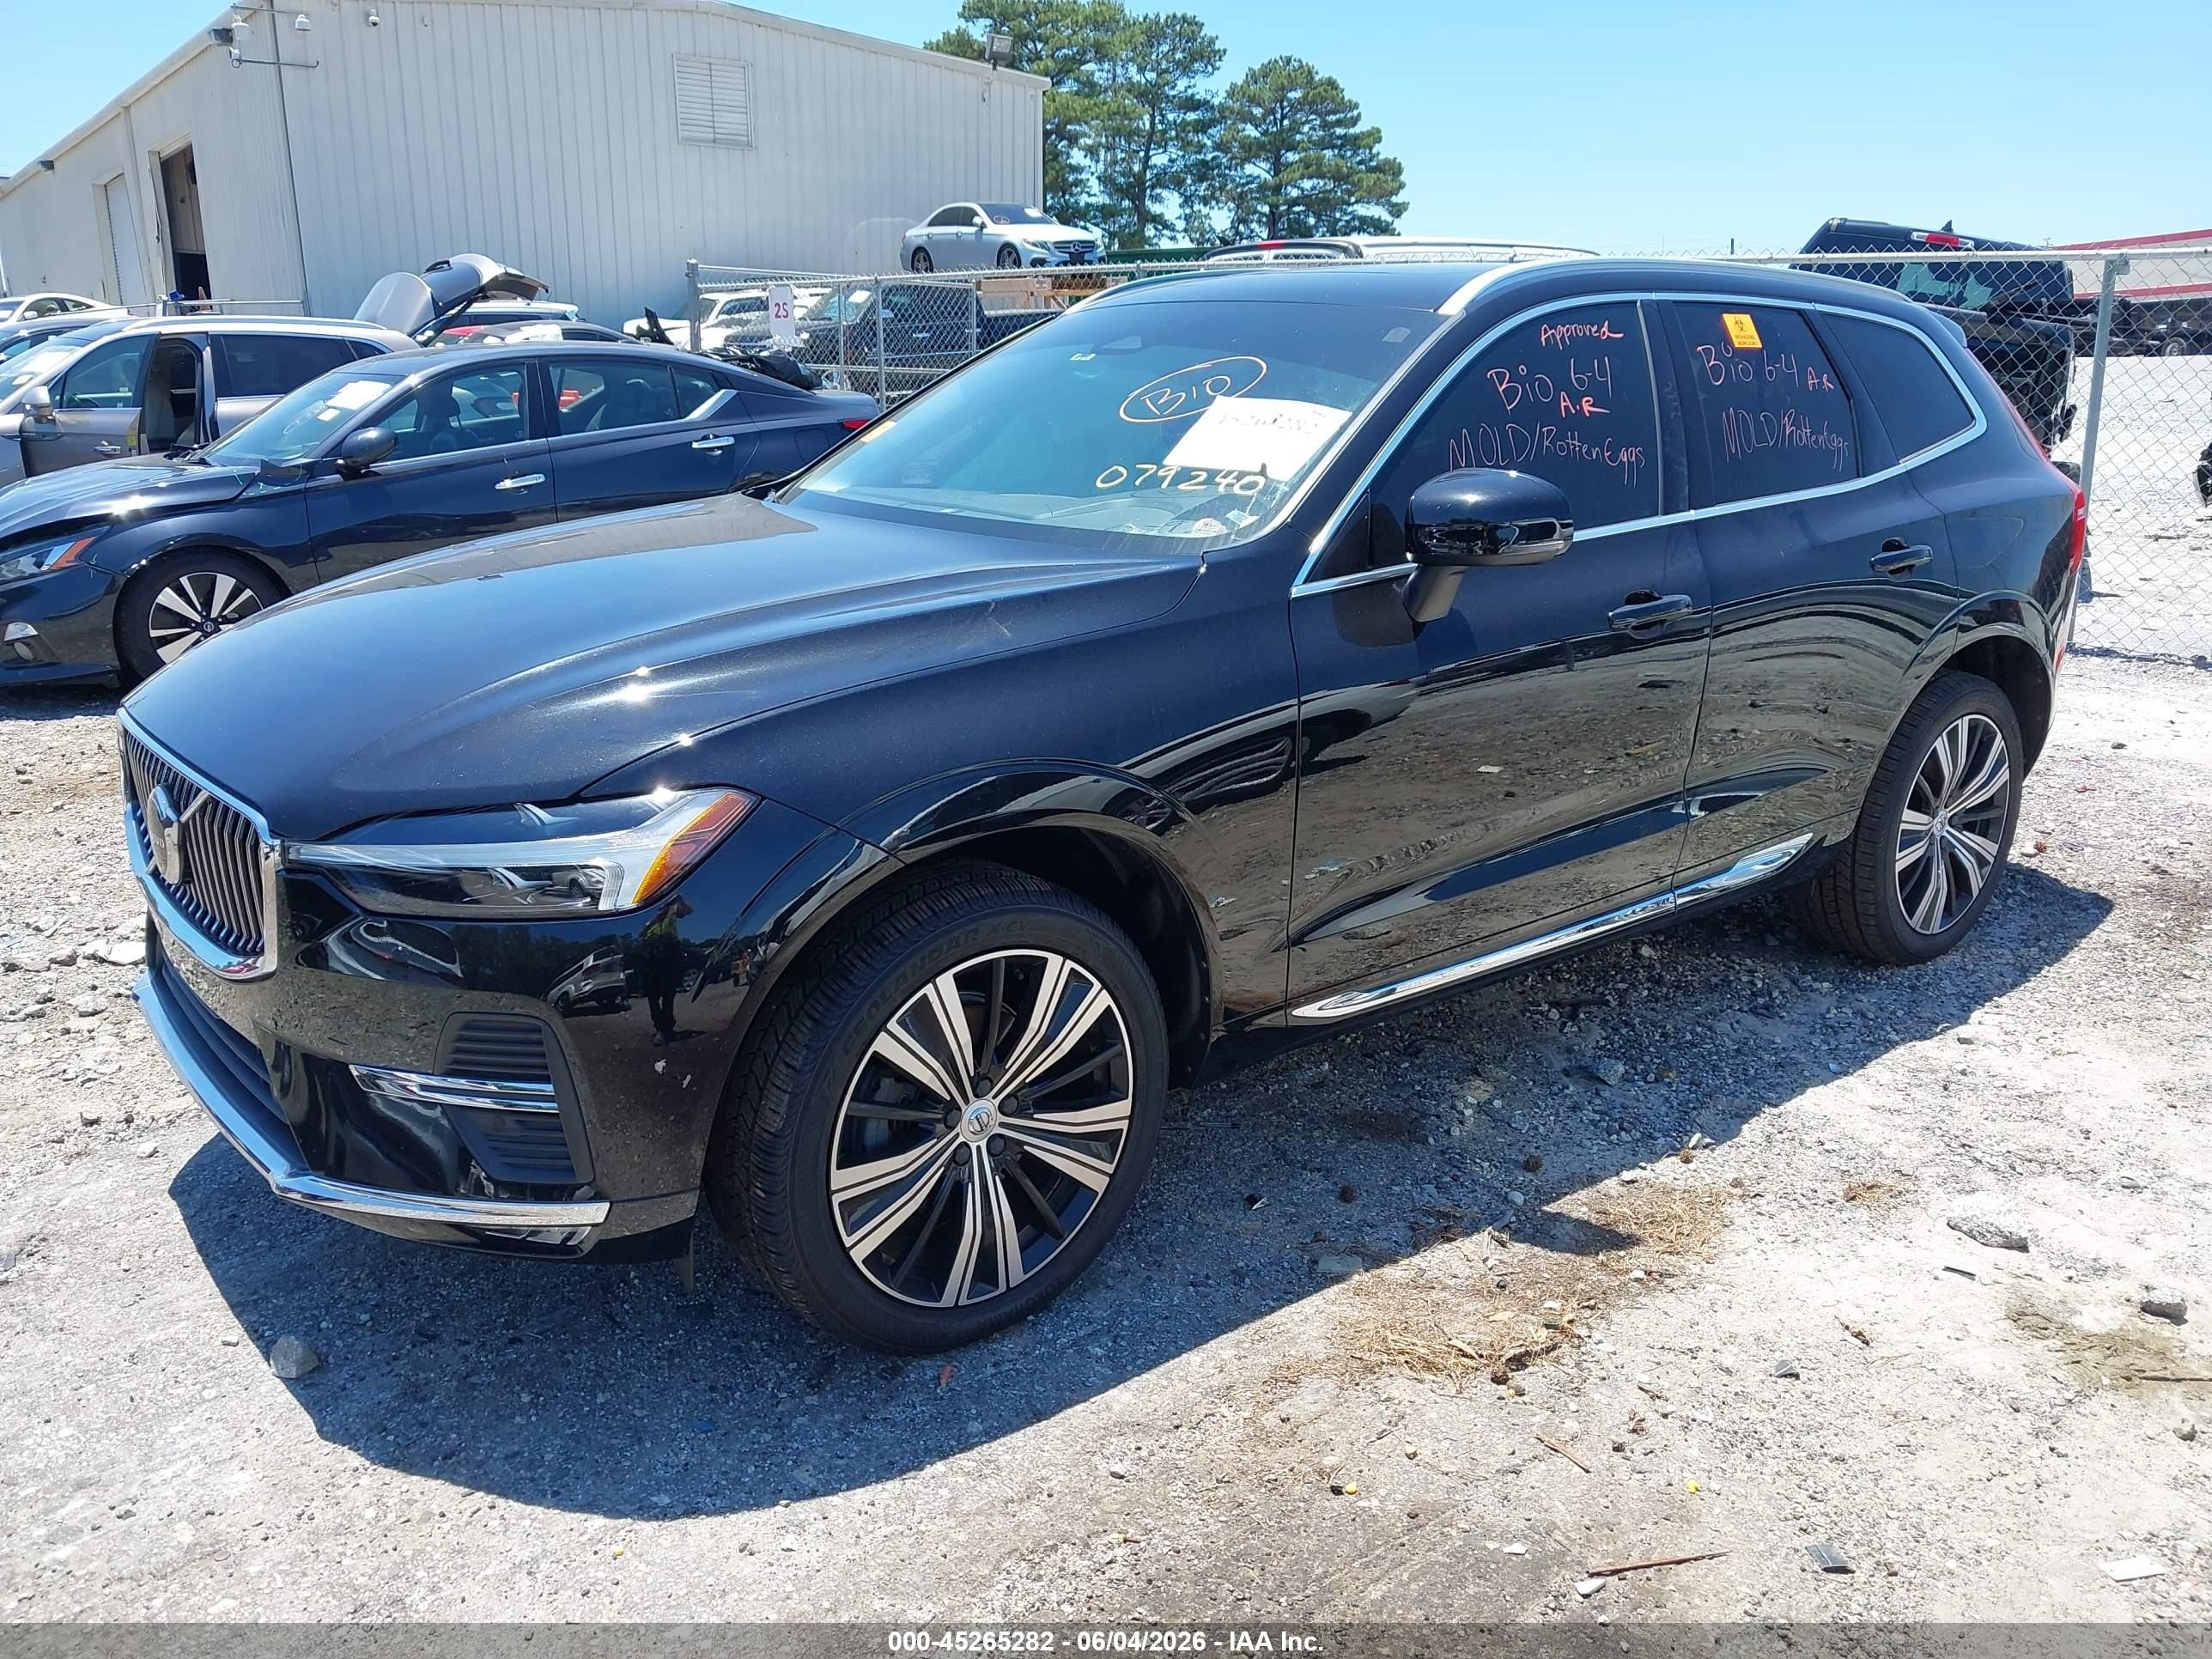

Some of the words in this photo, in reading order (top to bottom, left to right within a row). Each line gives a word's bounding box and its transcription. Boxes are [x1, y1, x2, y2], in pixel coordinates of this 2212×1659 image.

[1540, 320, 1624, 349] Approved
[1570, 356, 1612, 398] 6-4
[1763, 349, 1799, 387] 6-4
[1095, 463, 1266, 496] 079240
